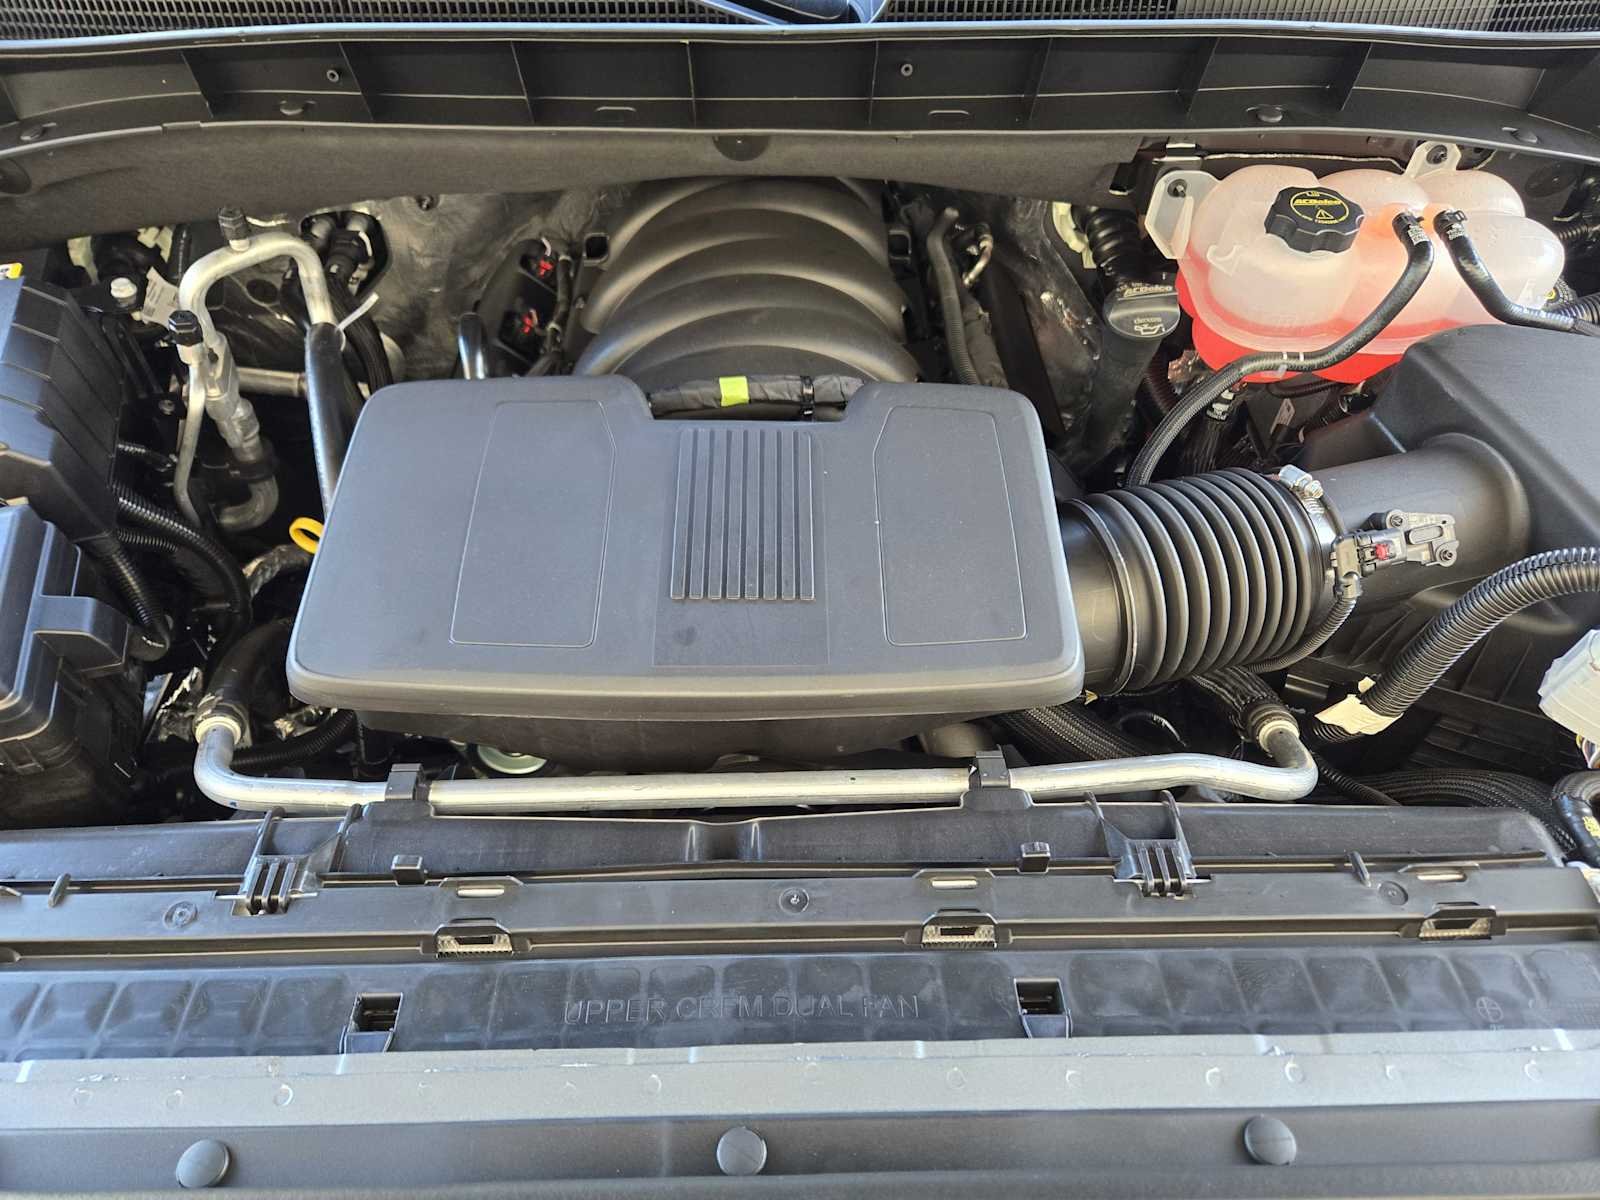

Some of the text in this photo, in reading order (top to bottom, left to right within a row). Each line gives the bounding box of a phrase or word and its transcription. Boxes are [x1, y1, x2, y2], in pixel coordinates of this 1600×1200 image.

[564, 999, 665, 1024] UPPER
[773, 995, 853, 1017] DUAL
[863, 995, 919, 1018] FAN
